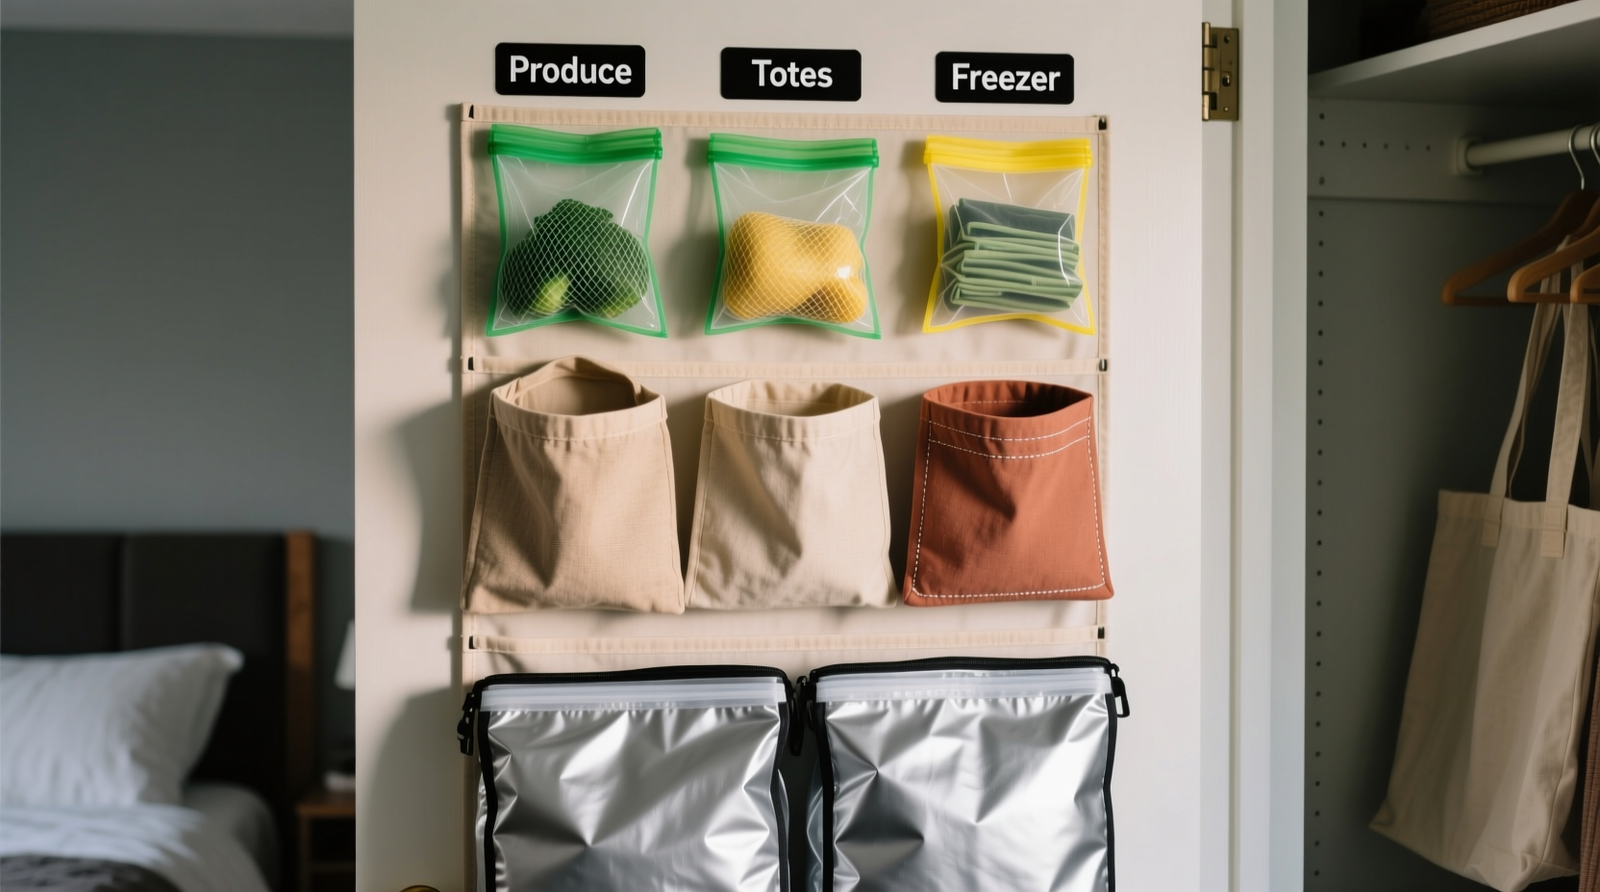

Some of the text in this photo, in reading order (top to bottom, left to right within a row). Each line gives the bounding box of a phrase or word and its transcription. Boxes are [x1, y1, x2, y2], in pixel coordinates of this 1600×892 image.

[509, 55, 632, 85] Produce
[752, 59, 833, 88] Totes
[952, 62, 1061, 92] Freezer
